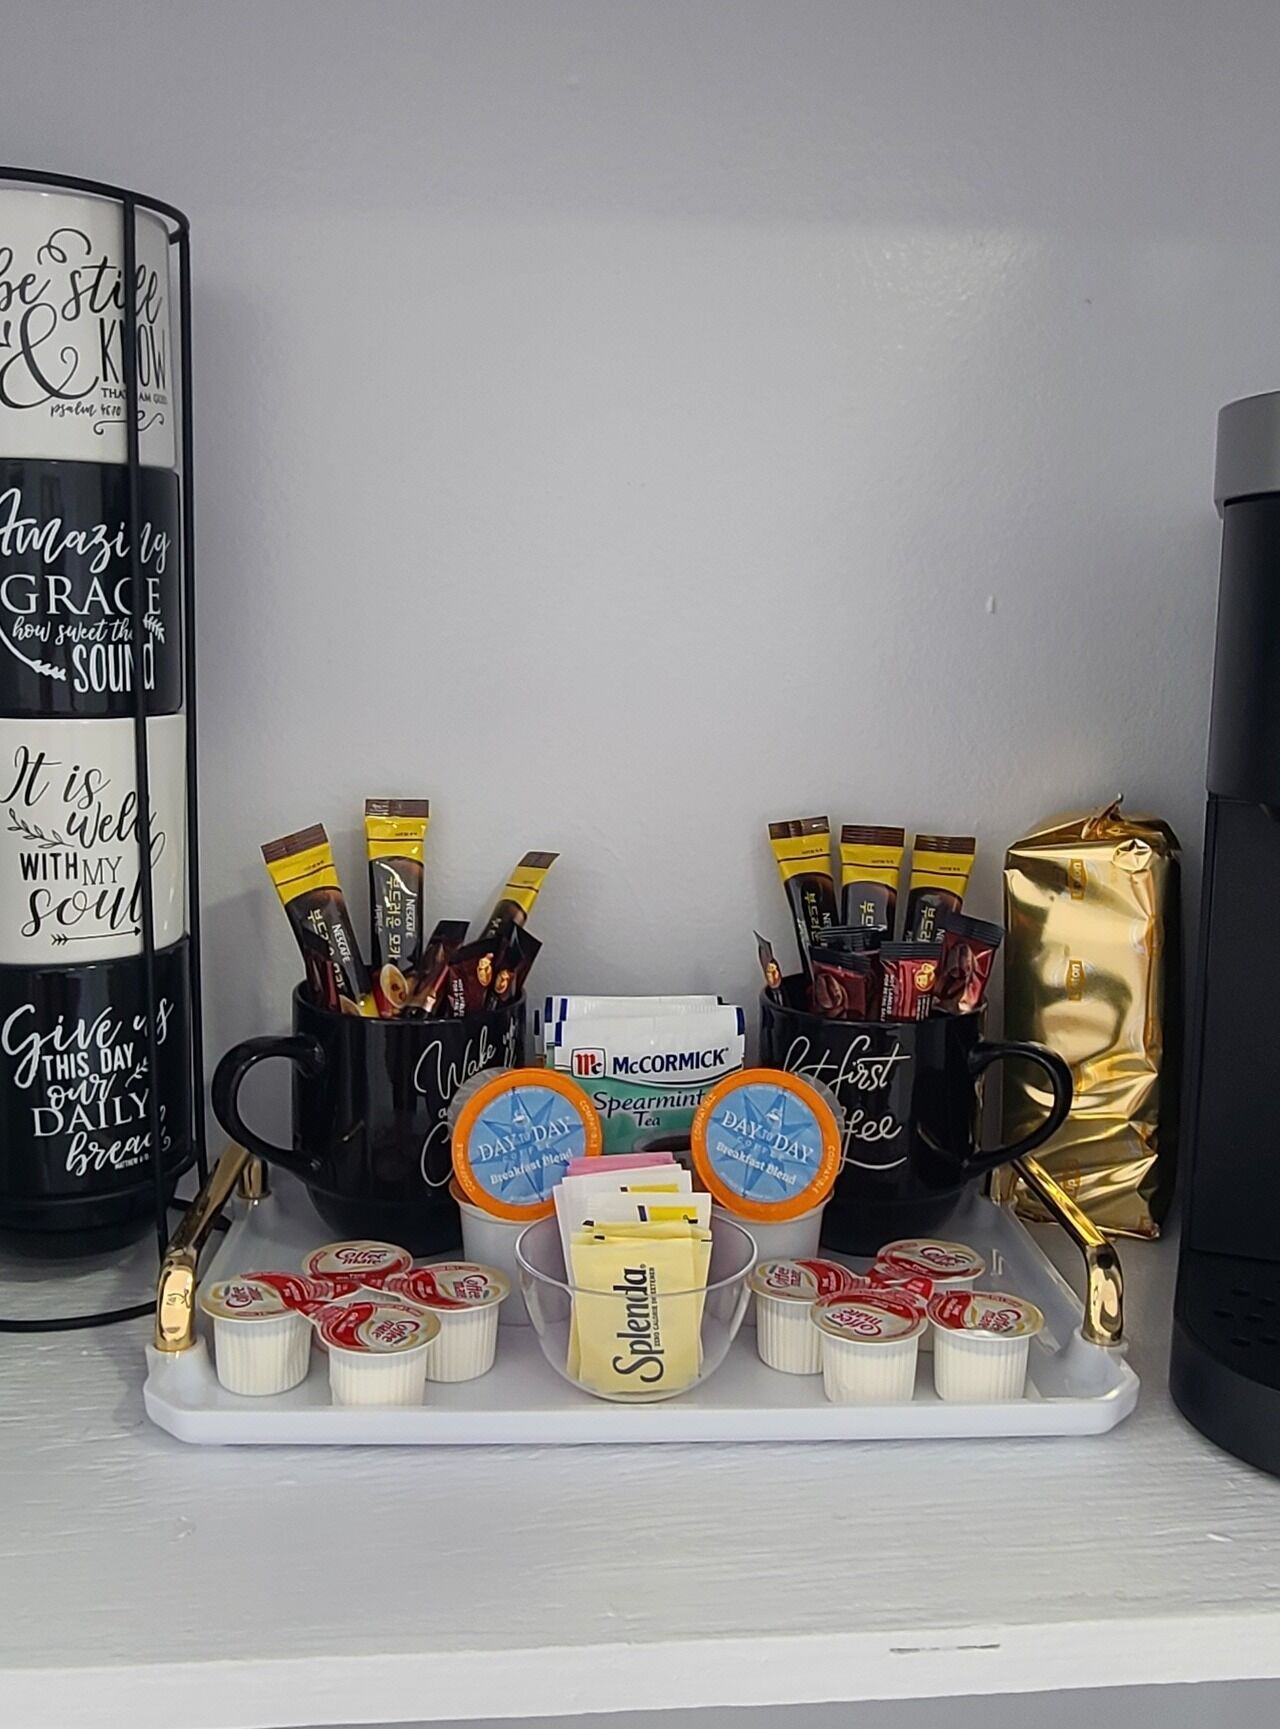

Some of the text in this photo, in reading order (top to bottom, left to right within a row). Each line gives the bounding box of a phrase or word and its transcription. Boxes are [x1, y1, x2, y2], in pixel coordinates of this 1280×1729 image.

[99, 318, 166, 391] KOW
[0, 574, 161, 616] GRACE
[12, 616, 51, 643] how
[55, 619, 108, 645] sweet
[63, 765, 111, 810] is
[20, 852, 122, 886] WITH MY
[1, 1003, 123, 1089] Give
[41, 1042, 134, 1081] THIS DAY
[414, 1025, 496, 1100] Wake
[613, 1050, 725, 1075] McCORMICK
[31, 1088, 149, 1137] DAILY
[46, 1073, 117, 1110] our
[592, 1089, 706, 1120] Spearmint
[478, 1132, 517, 1162] DAY
[531, 1117, 571, 1142] DAY
[632, 1111, 661, 1127] Tea
[721, 1110, 761, 1139] DAY
[773, 1132, 814, 1164] DAY
[489, 1147, 574, 1185] Breakfast Blend
[716, 1142, 797, 1185] Breakfast Blend
[335, 1248, 388, 1260] Coffee
[612, 1267, 665, 1383] Splenda
